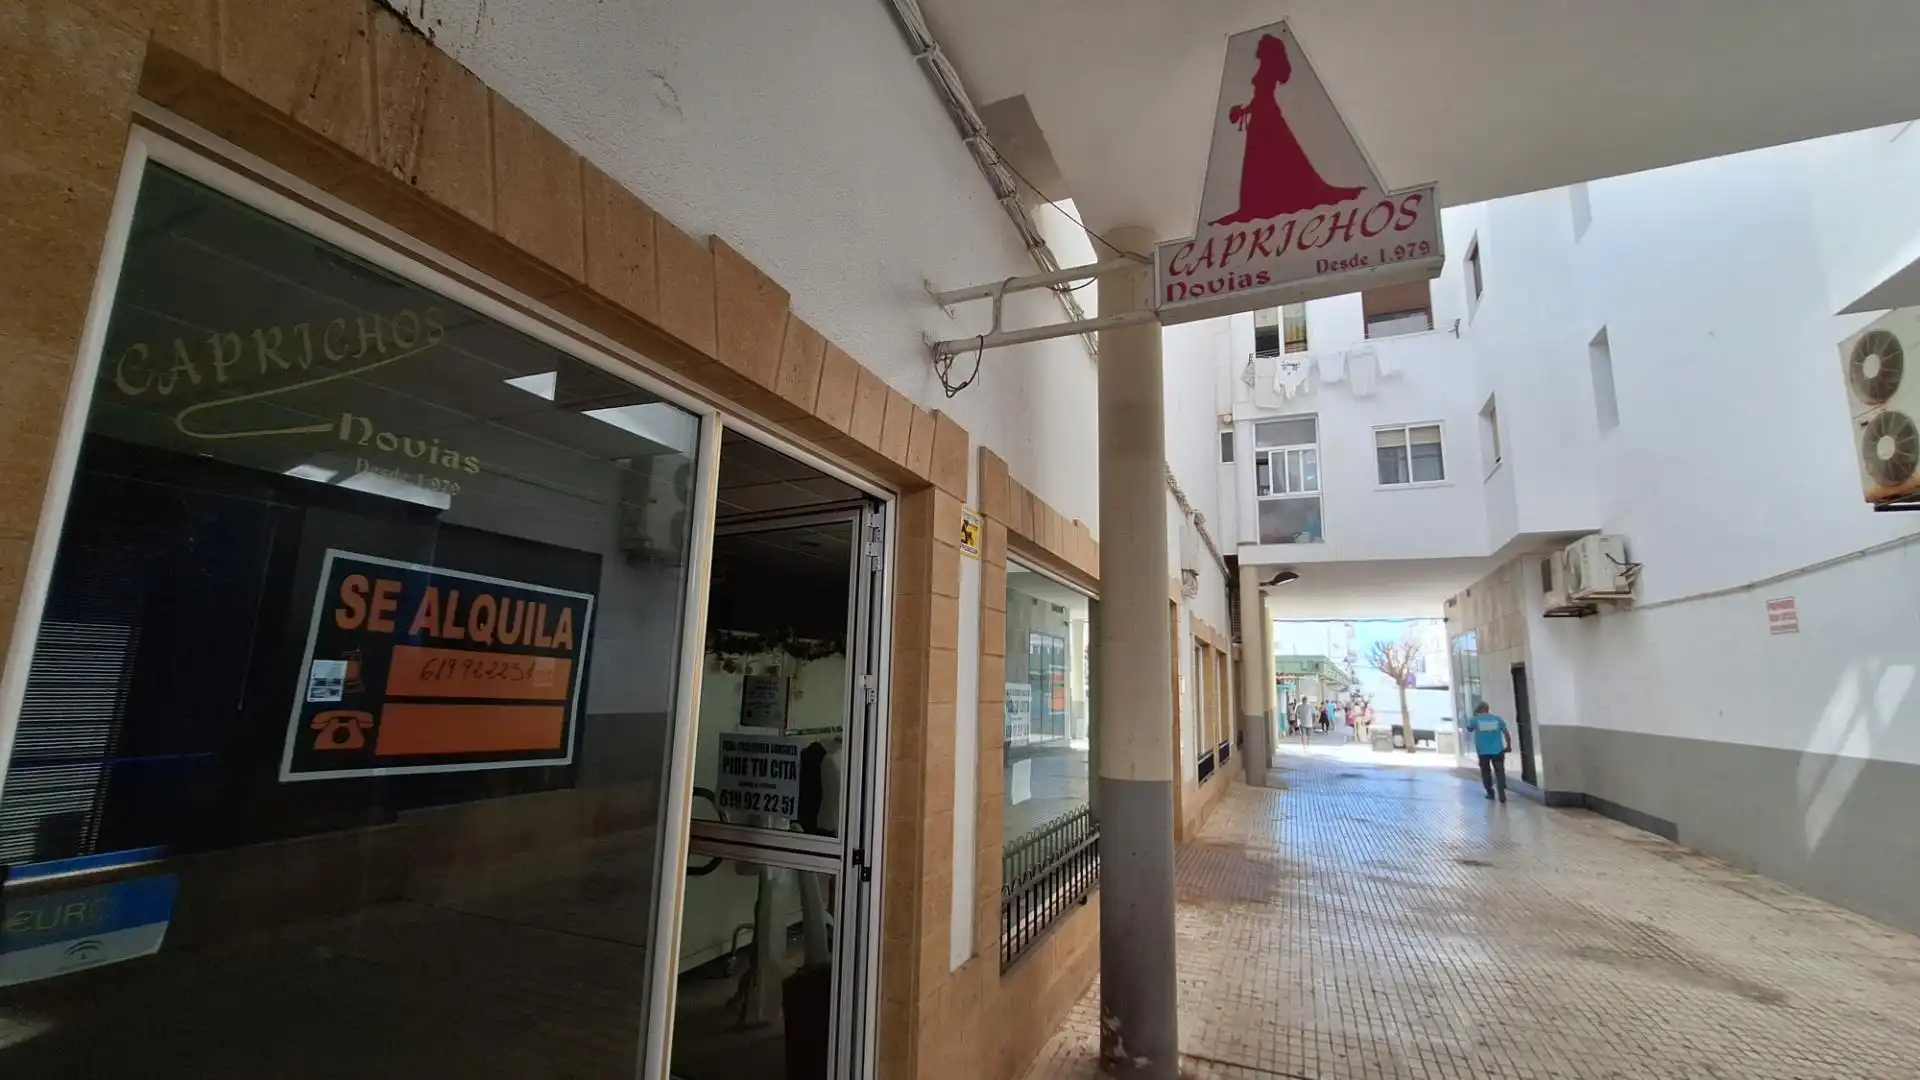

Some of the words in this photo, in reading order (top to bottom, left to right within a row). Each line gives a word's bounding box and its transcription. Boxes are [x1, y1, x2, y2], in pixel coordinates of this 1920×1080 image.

[1168, 193, 1423, 277] CAPRICHOS
[1315, 252, 1369, 275] Desde
[1379, 239, 1432, 264] 1.979
[113, 306, 446, 396] CAPRICHOS
[417, 473, 462, 497] 1979
[335, 573, 403, 634] SE
[408, 585, 575, 651] ALQUILA
[722, 755, 749, 777] PIDE
[750, 757, 769, 778] TU
[770, 759, 797, 781] CITA
